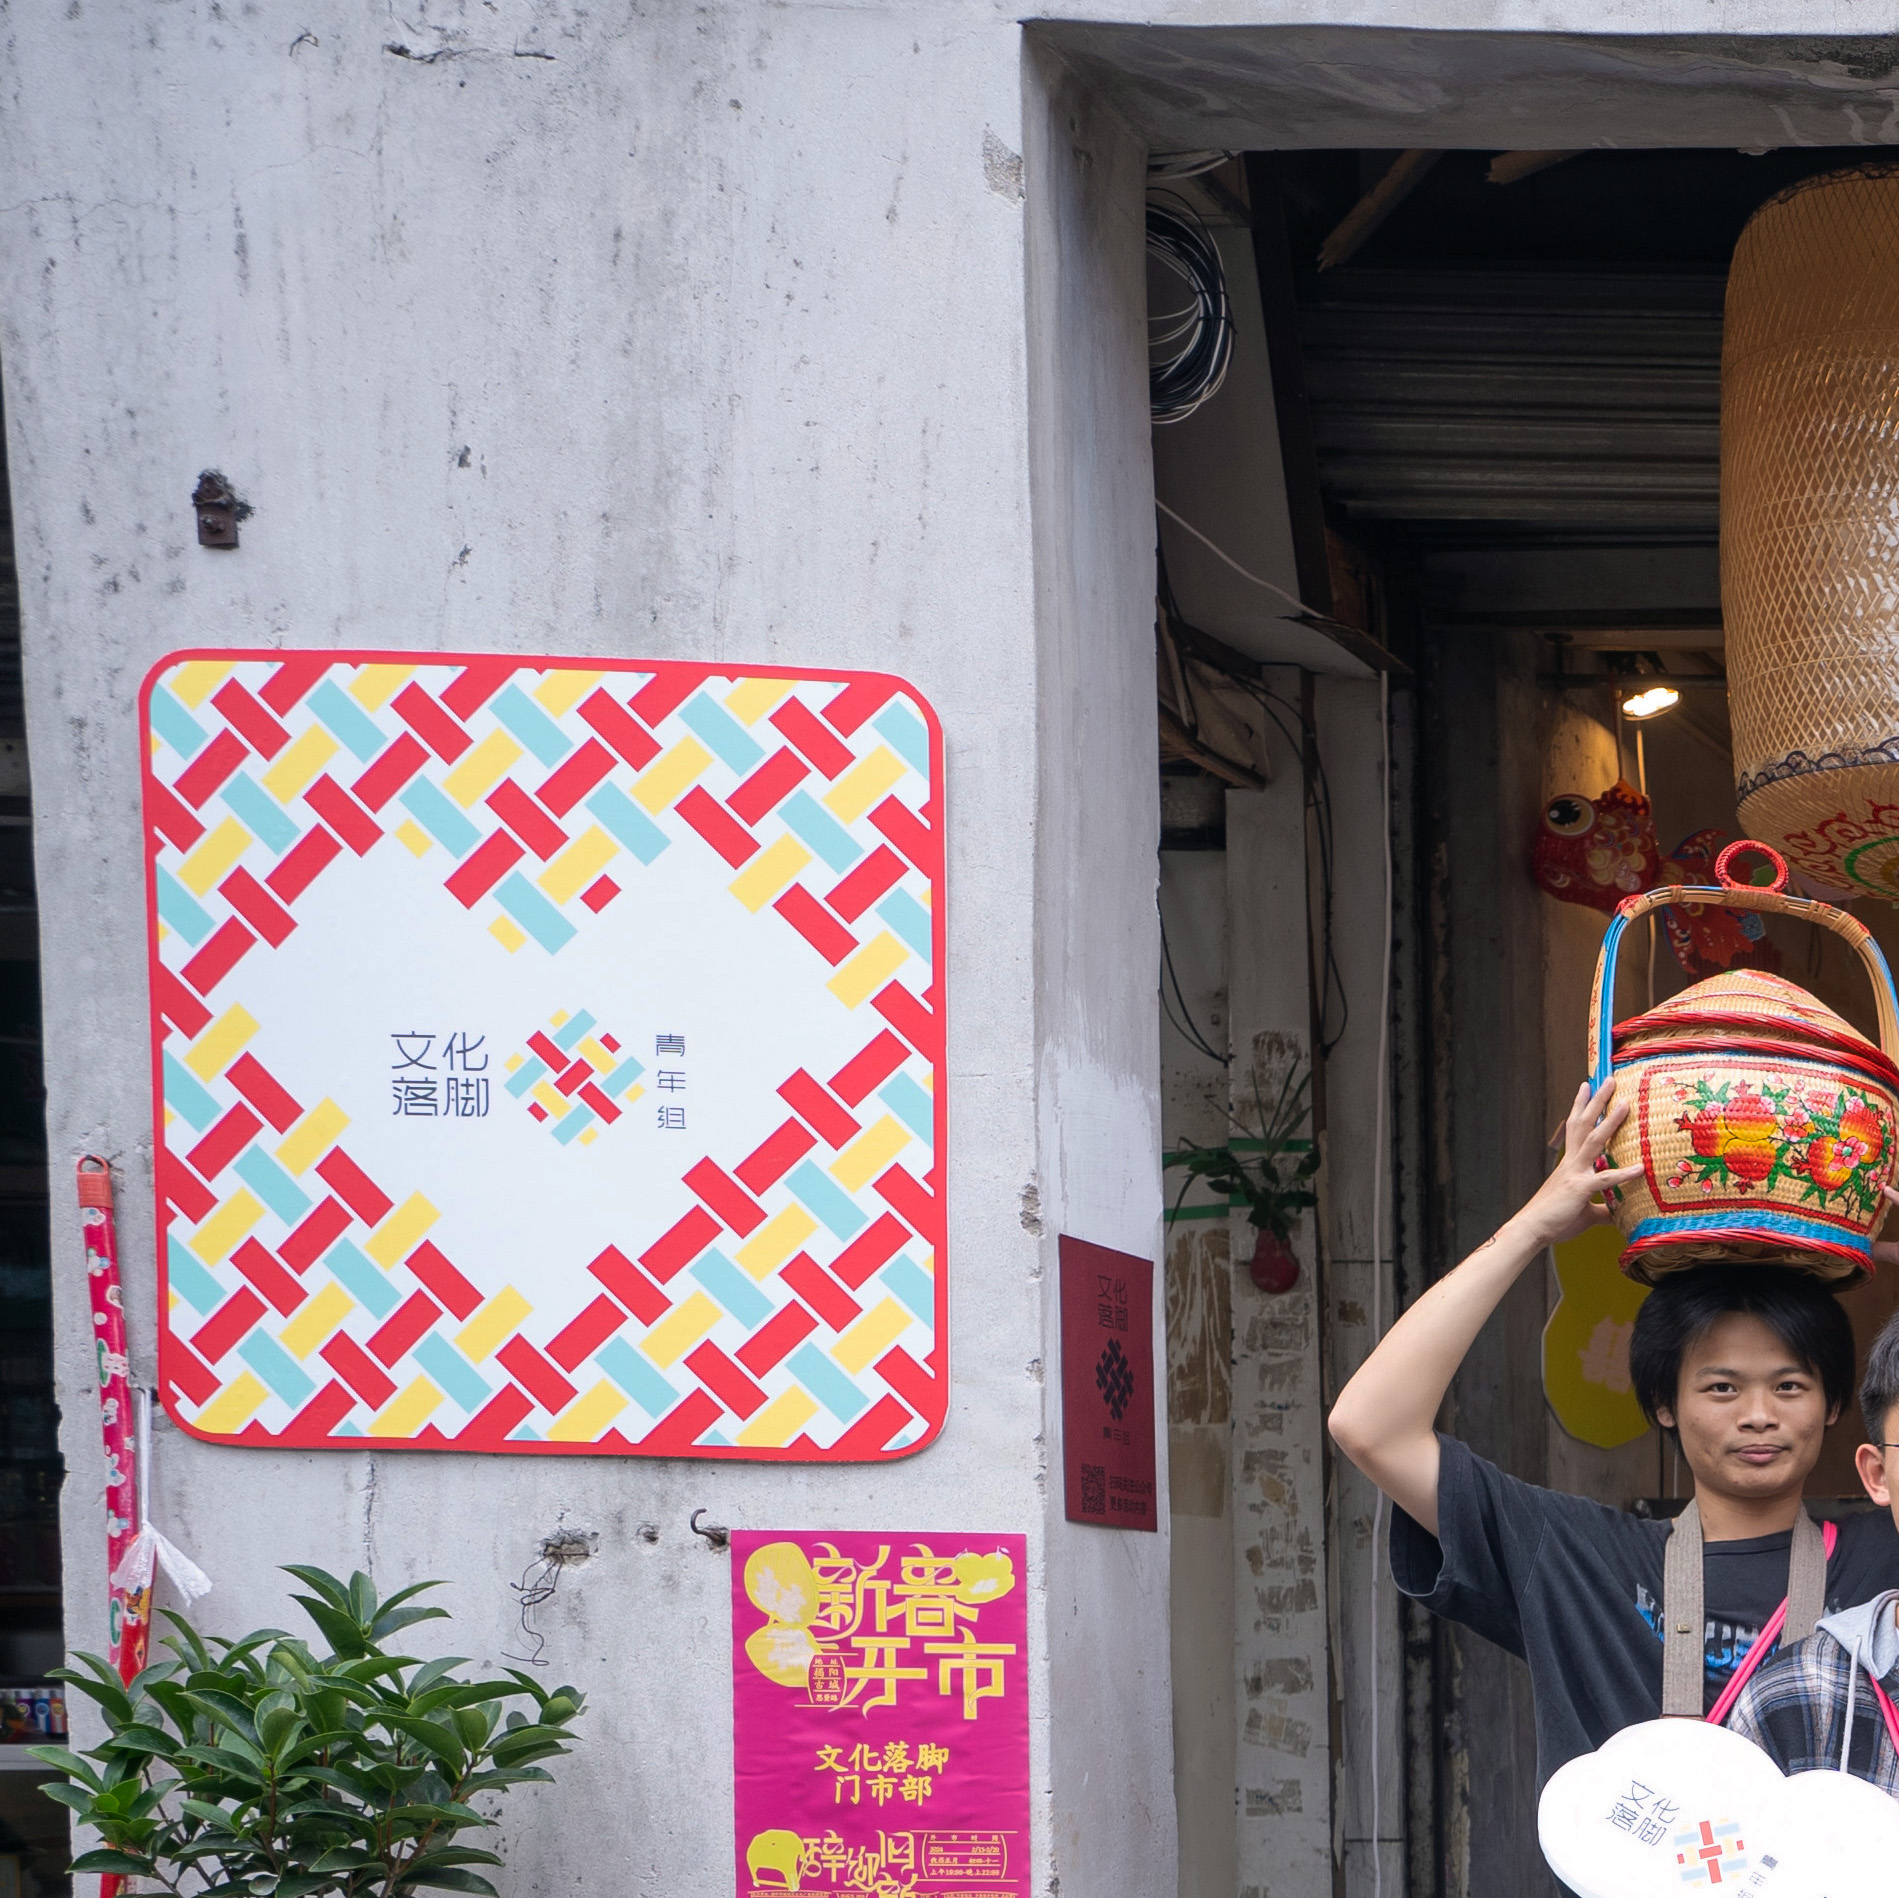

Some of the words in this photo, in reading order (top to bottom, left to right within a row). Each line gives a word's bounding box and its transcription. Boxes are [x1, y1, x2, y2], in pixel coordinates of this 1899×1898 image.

[390, 1030, 489, 1072] 文化
[391, 1077, 490, 1118] 落脚
[655, 1033, 687, 1130] 青年组
[812, 1542, 980, 1641] 新春
[813, 1679, 840, 1691] 古城
[828, 1625, 1017, 1720] 开市
[813, 1741, 950, 1774] 文化落脚
[834, 1774, 933, 1807] 门市部
[1620, 1780, 1680, 1824] 文化
[1605, 1802, 1667, 1847] 落脚
